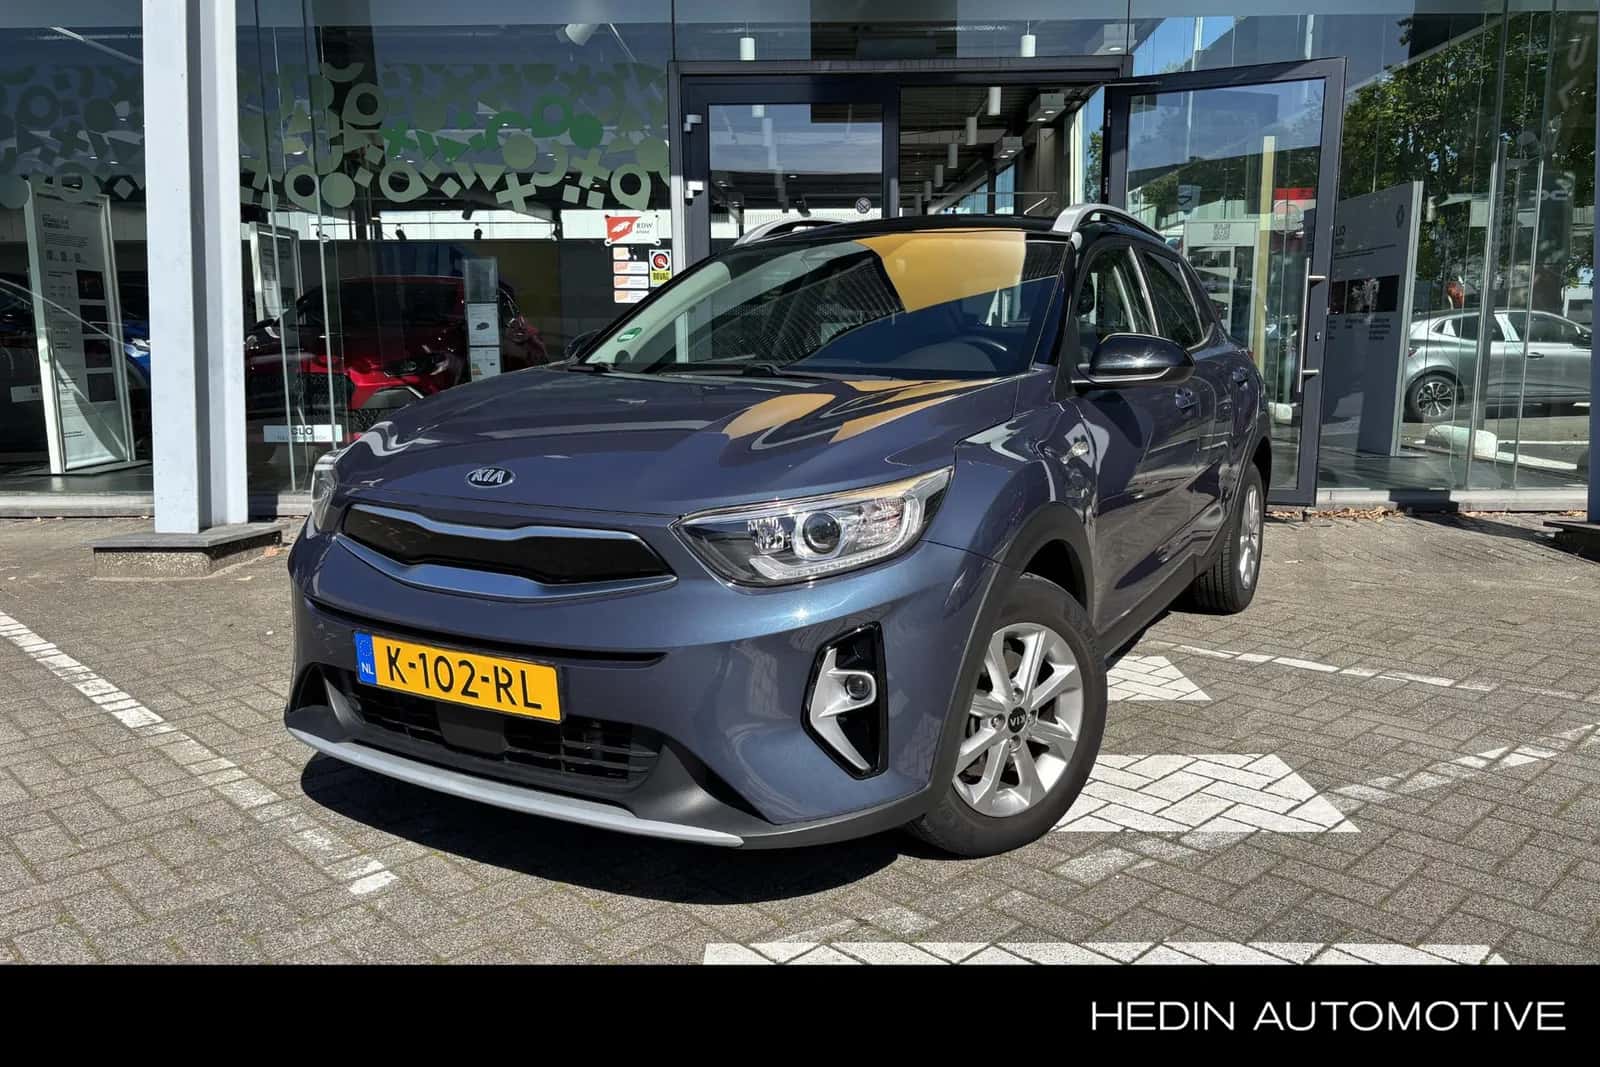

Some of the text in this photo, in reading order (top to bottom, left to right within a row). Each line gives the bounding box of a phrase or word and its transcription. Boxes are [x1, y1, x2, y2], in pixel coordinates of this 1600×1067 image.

[470, 468, 506, 484] KIA
[361, 662, 375, 676] NL
[386, 645, 542, 711] K-102-RL
